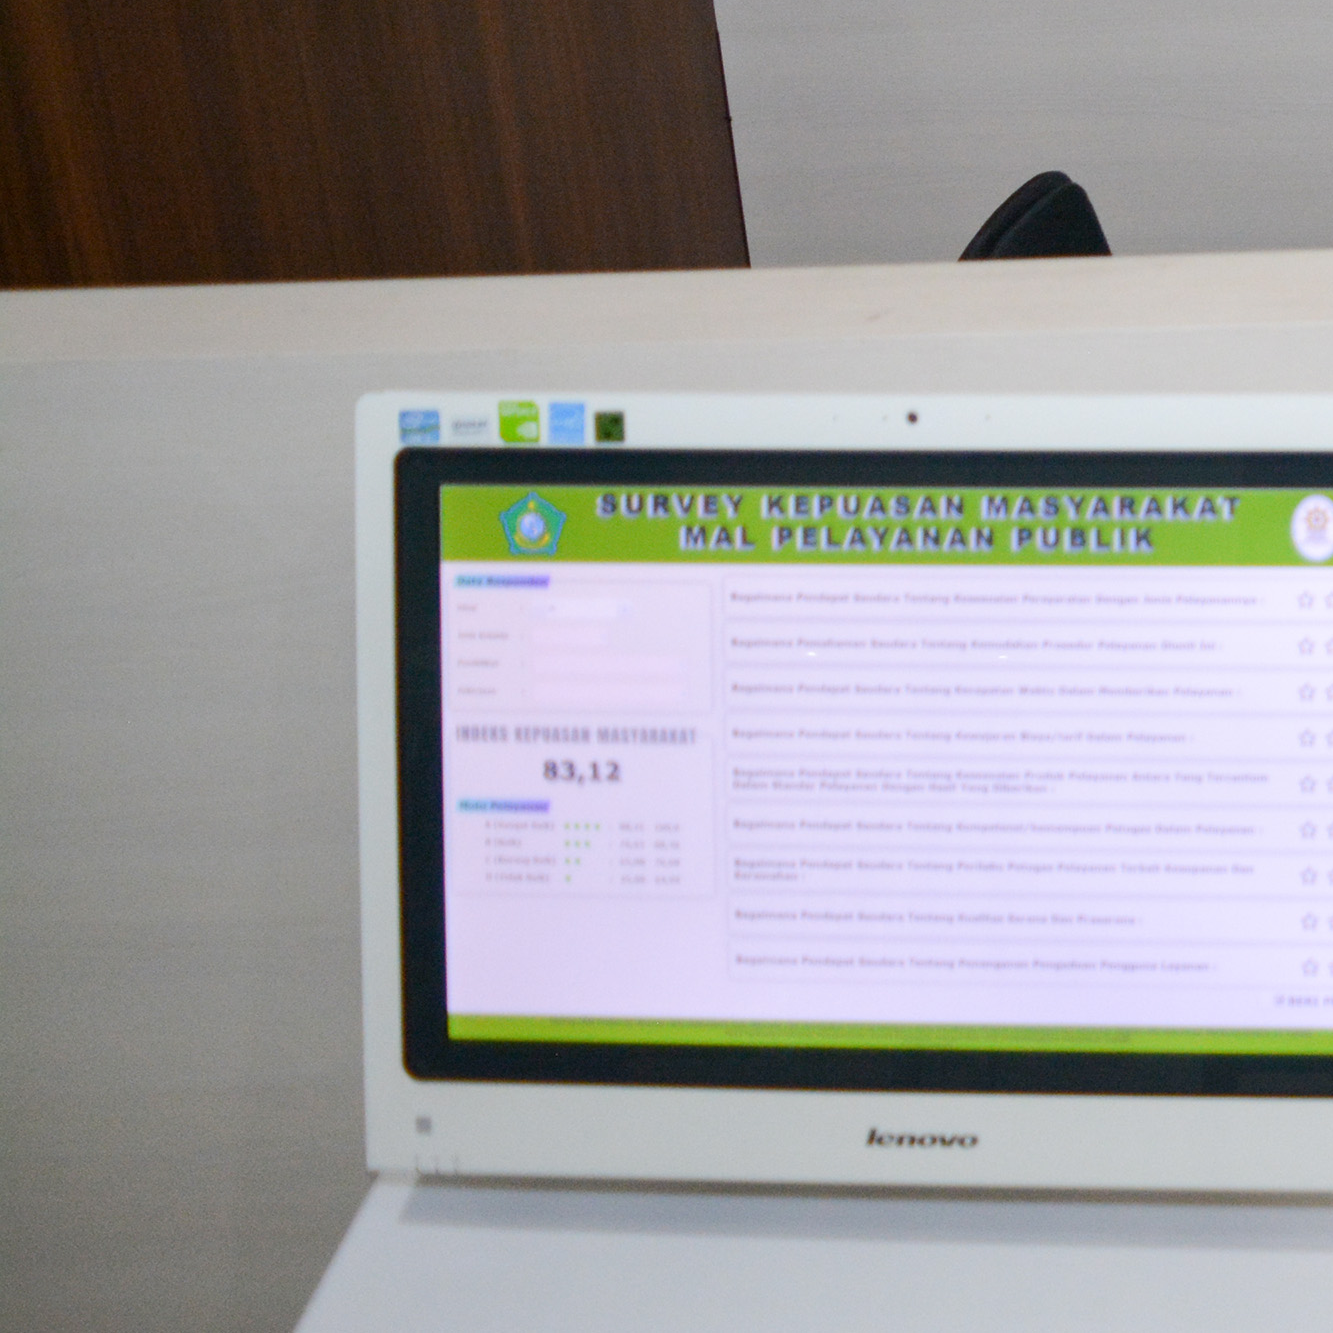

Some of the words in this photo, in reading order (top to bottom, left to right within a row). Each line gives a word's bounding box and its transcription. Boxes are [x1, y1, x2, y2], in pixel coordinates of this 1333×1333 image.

[595, 493, 742, 519] SURVEY
[760, 494, 964, 520] KEPUASAN
[981, 495, 1241, 522] MASYARAKAT
[678, 525, 755, 551] MAL
[771, 525, 995, 552] PELAYANAN
[1011, 527, 1155, 553] PUBLIK
[456, 724, 507, 742] INDEKS
[514, 725, 592, 744] KEPUASAN
[597, 726, 697, 745] MASYARAKAT
[542, 759, 621, 784] 83,12
[867, 1128, 979, 1146] lenovo
